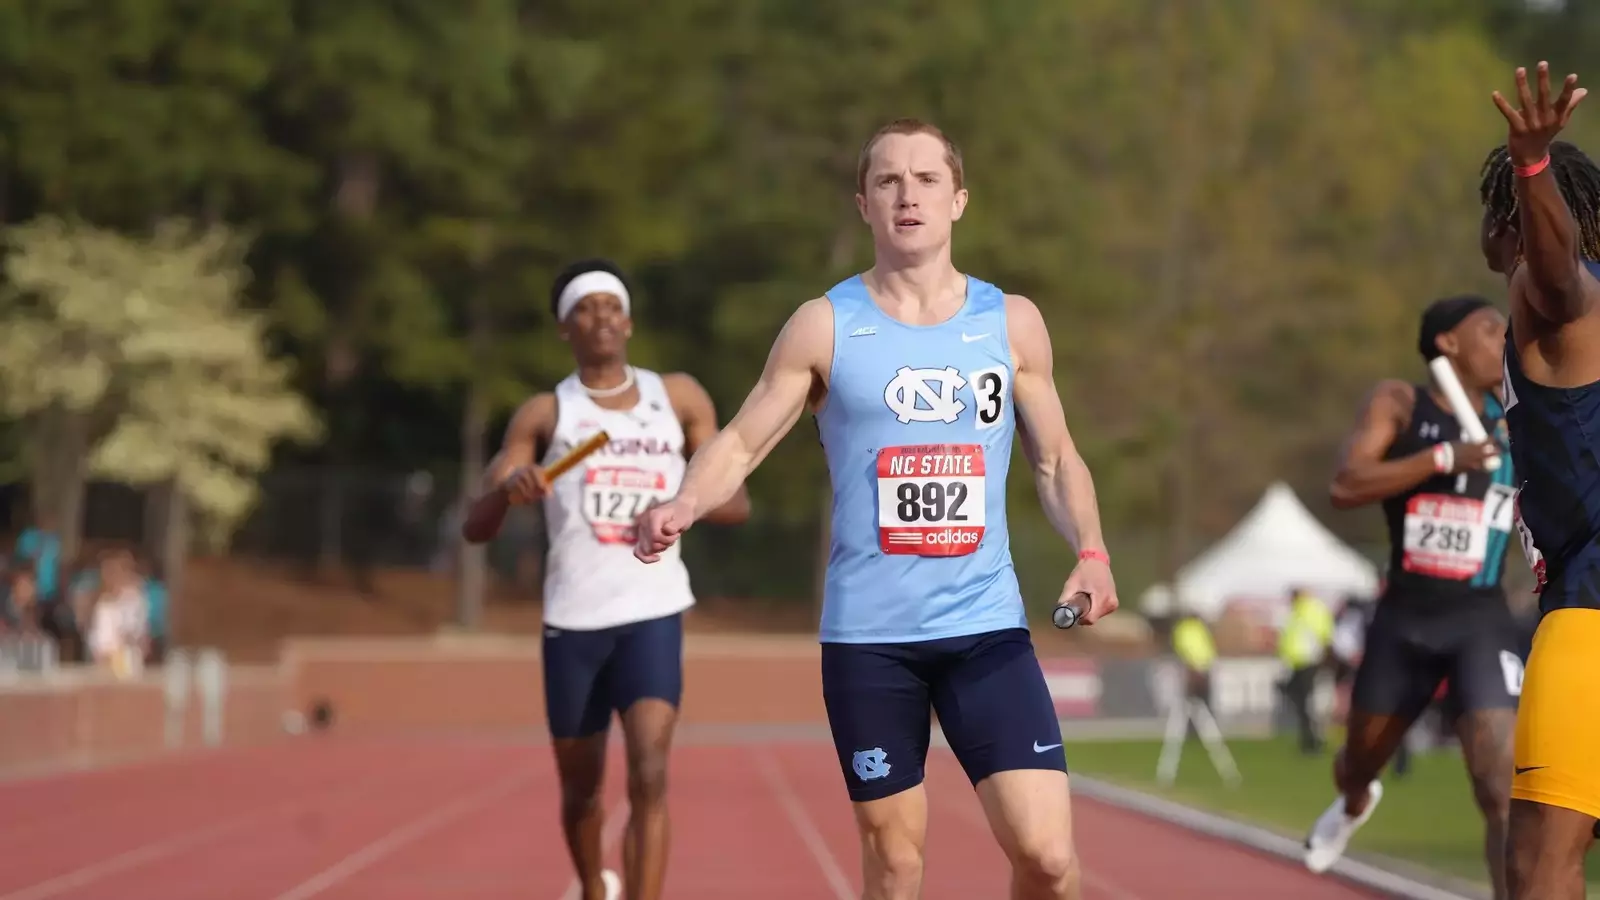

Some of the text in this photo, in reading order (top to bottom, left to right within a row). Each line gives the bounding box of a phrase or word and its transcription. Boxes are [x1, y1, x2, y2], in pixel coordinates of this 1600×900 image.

[851, 325, 879, 337] ACC
[978, 372, 1002, 424] 3
[890, 454, 973, 475] NC STATE
[897, 482, 968, 522] 892
[1492, 489, 1509, 521] 7
[926, 529, 978, 545] adidas
[1417, 522, 1472, 552] 239
